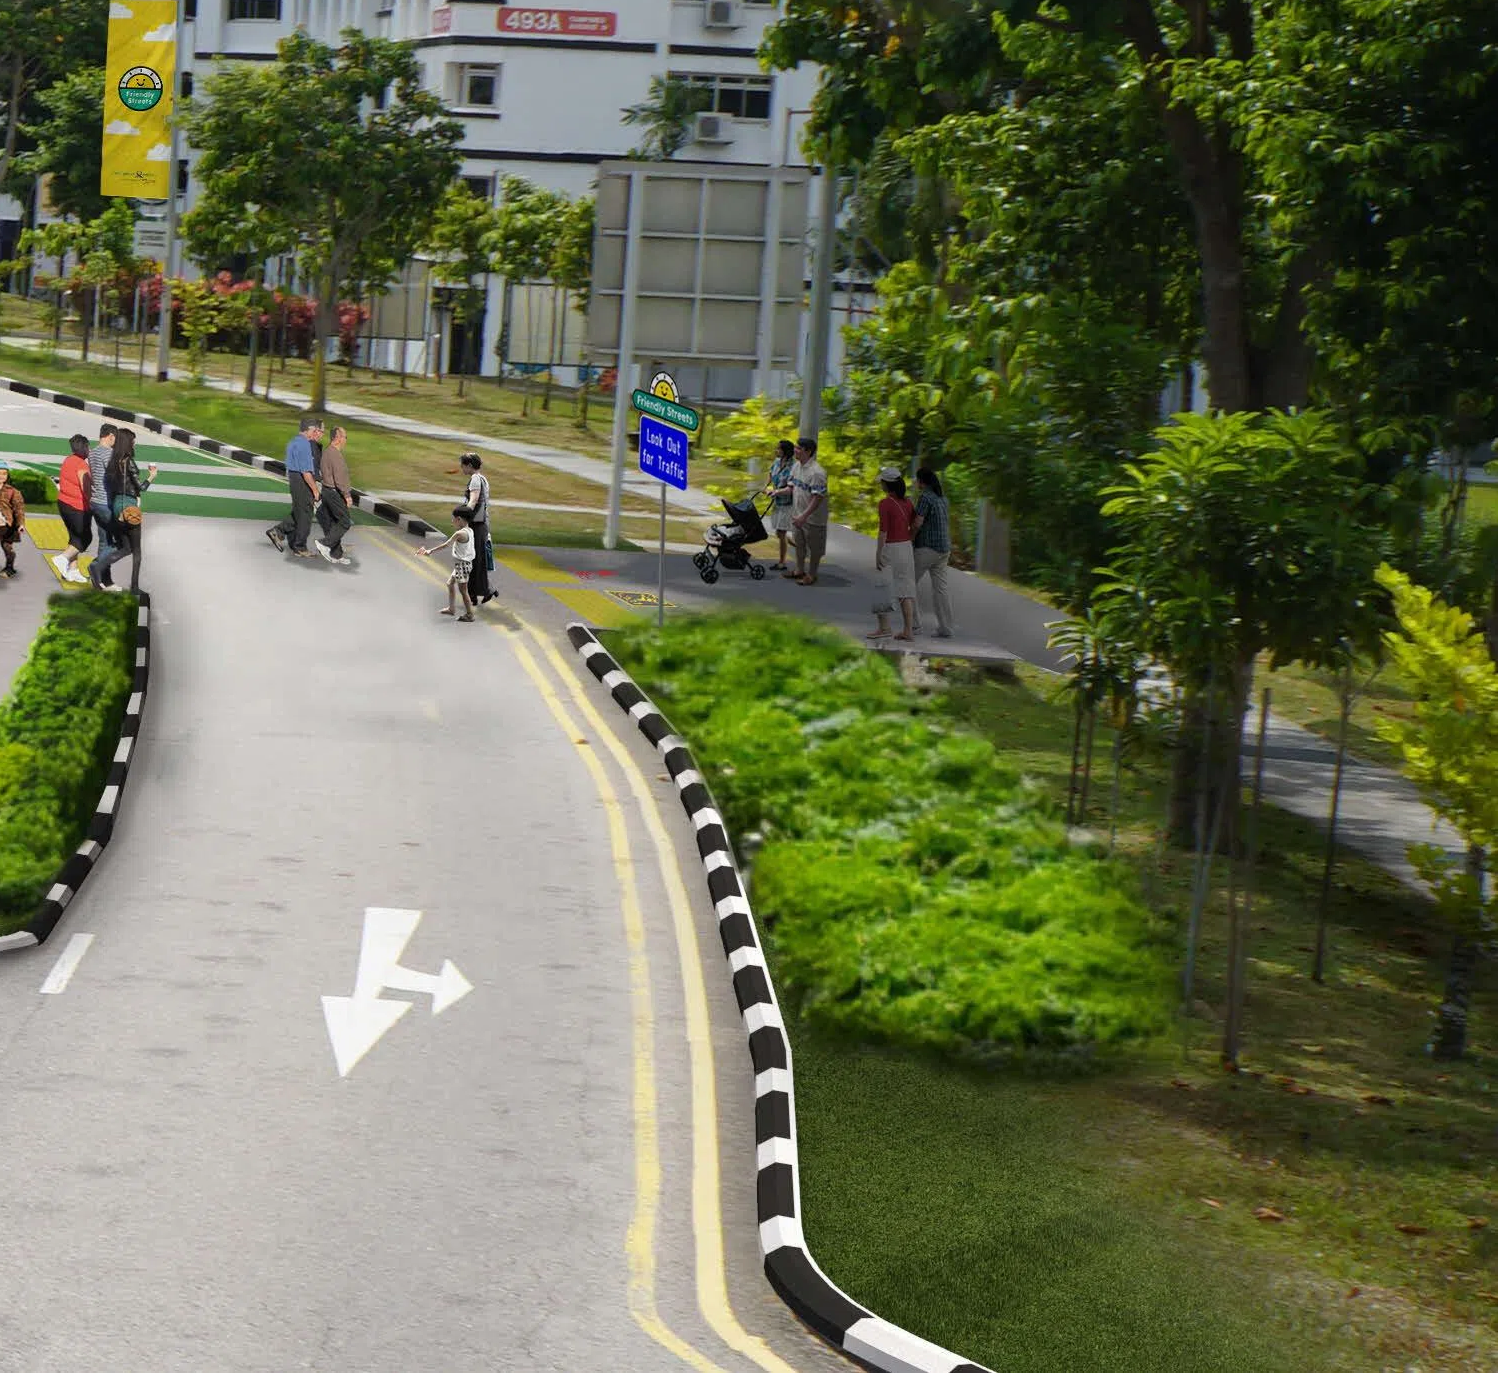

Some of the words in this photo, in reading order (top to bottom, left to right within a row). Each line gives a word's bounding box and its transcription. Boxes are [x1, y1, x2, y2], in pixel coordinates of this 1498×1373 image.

[506, 11, 562, 31] 493A
[126, 90, 154, 100] Friendly
[128, 97, 152, 105] Streets
[637, 394, 665, 415] Friendly
[667, 407, 693, 425] Streets
[646, 428, 663, 448] Look
[666, 437, 681, 456] Out
[642, 448, 654, 466] for
[658, 455, 685, 481] Traffic
